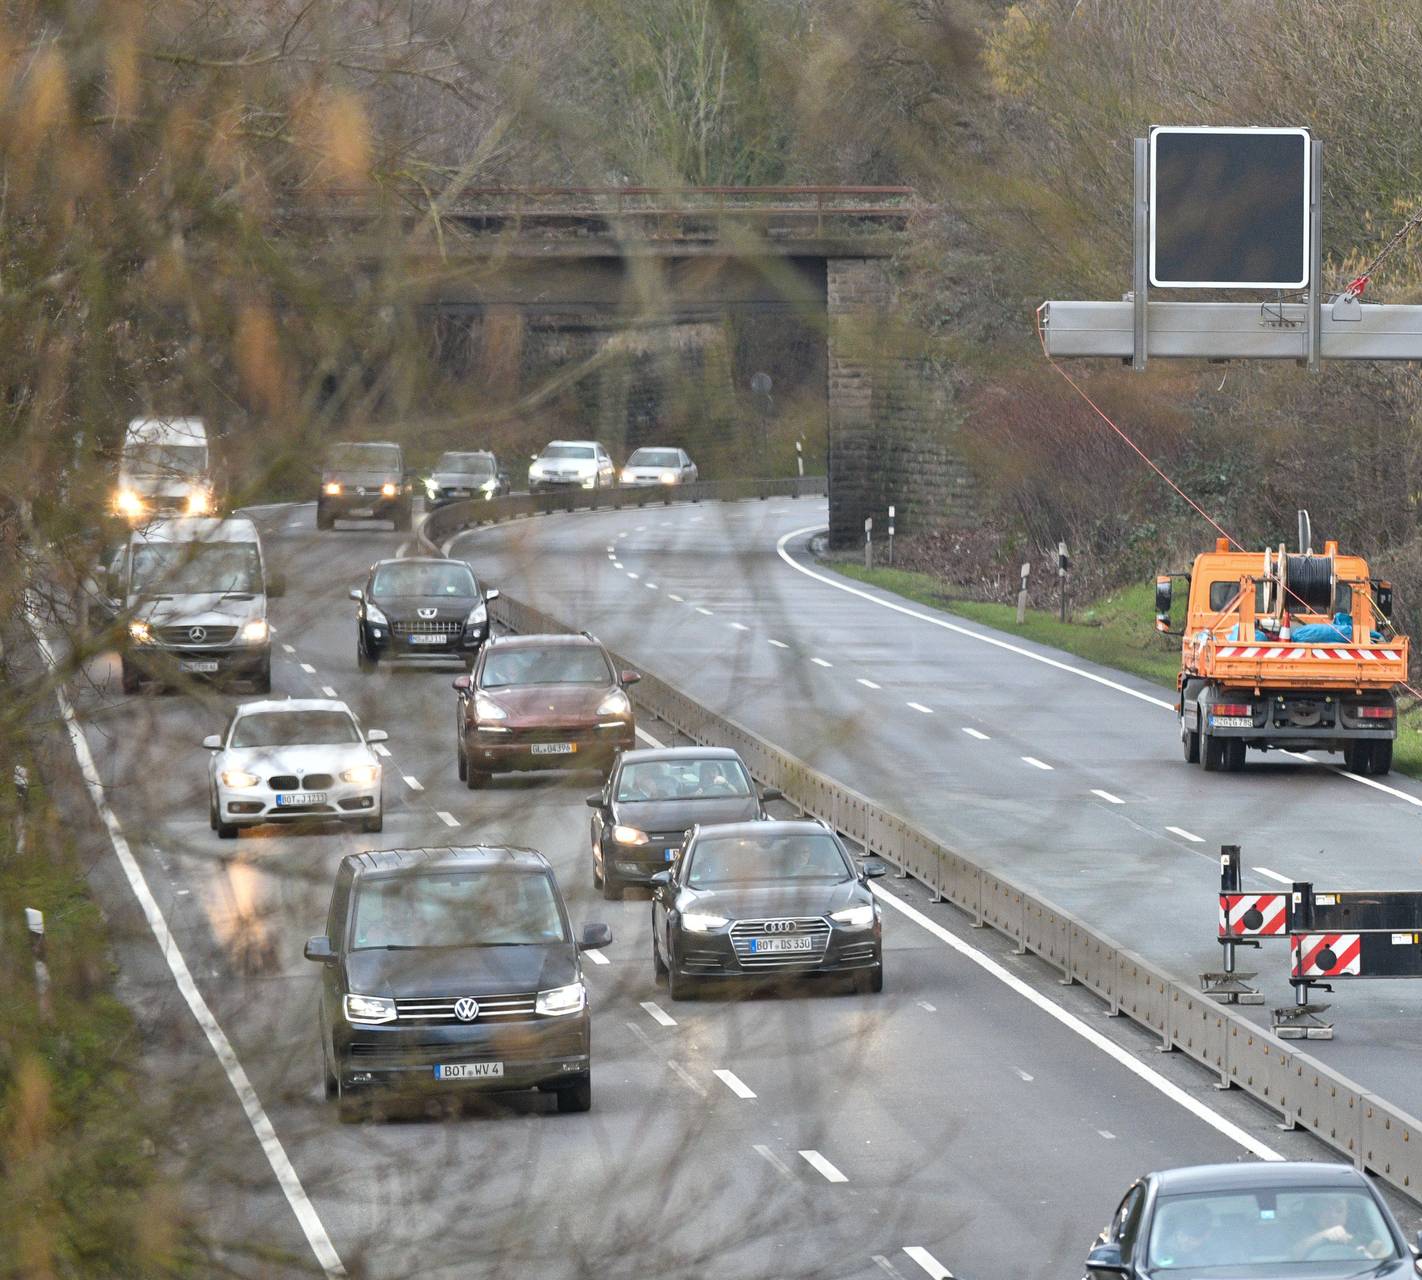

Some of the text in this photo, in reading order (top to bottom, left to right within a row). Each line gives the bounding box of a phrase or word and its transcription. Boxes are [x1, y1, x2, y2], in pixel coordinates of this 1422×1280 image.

[756, 940, 774, 951] BOT
[793, 938, 810, 949] 330
[444, 1063, 499, 1077] BOT WV 4
